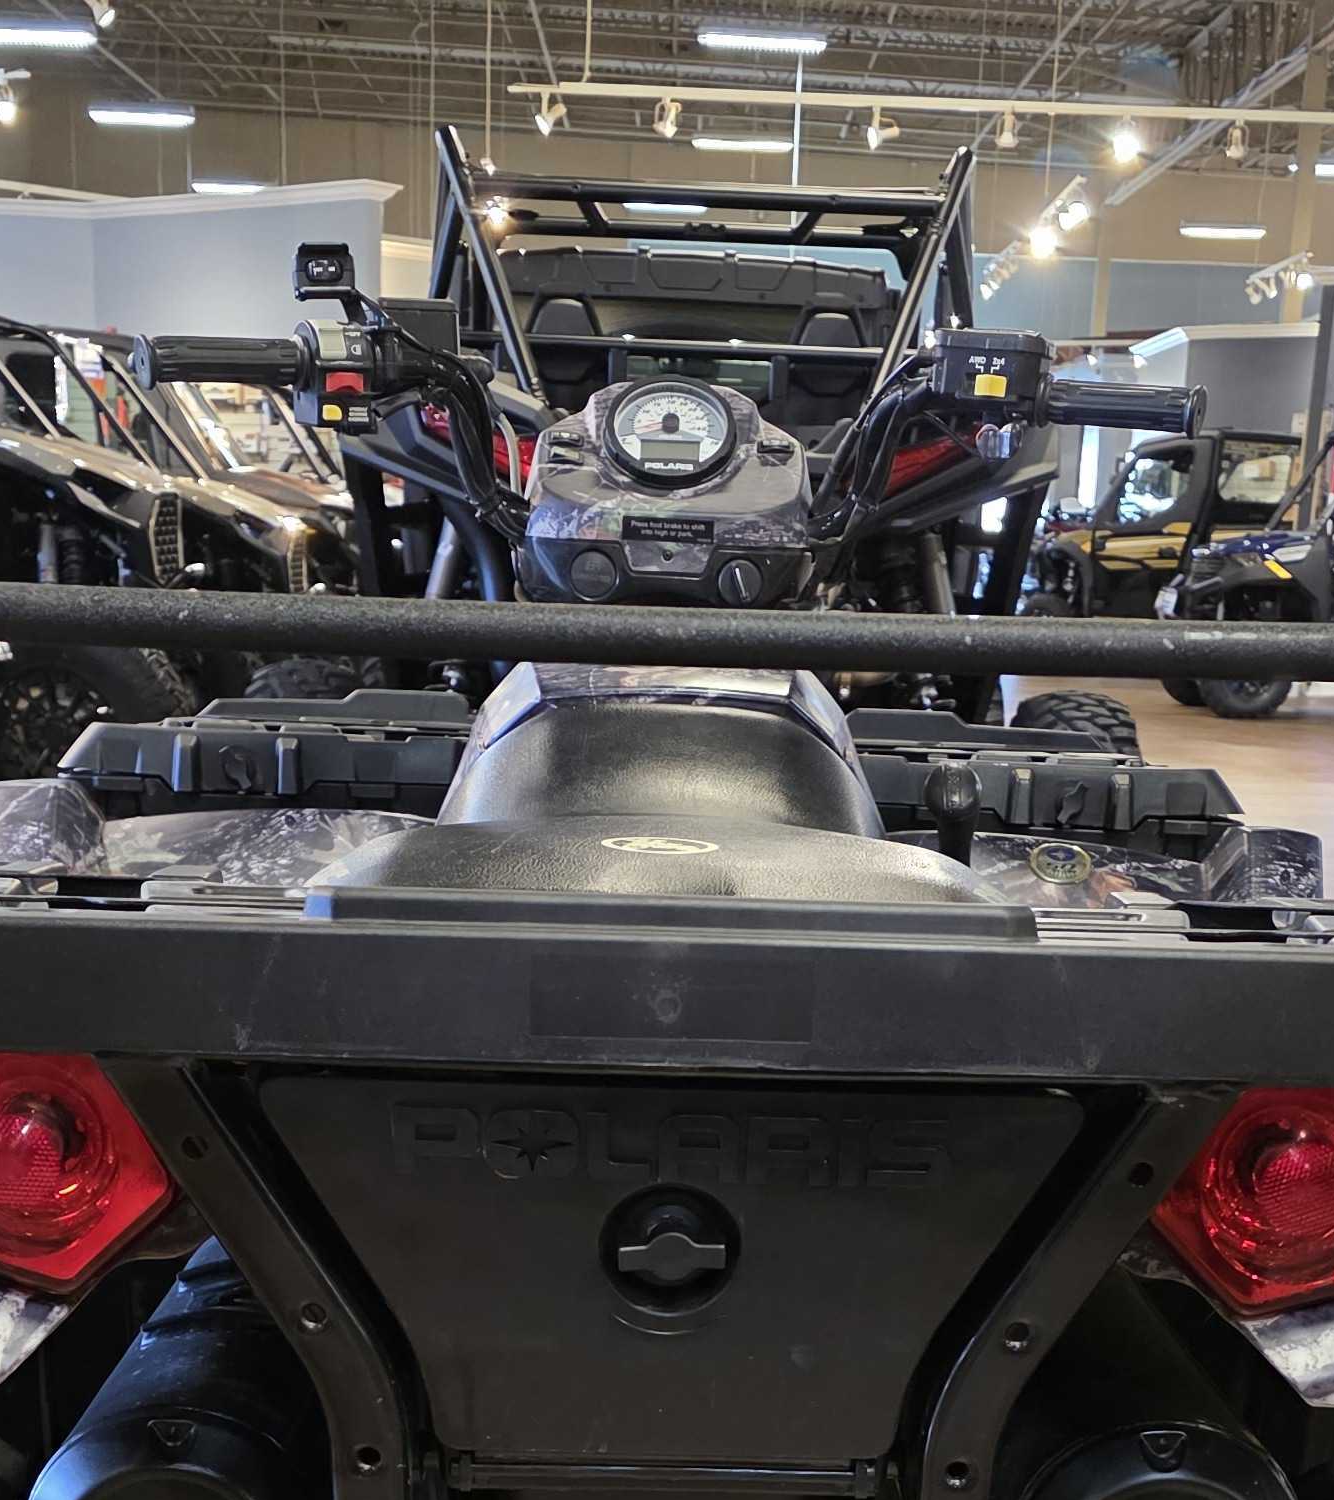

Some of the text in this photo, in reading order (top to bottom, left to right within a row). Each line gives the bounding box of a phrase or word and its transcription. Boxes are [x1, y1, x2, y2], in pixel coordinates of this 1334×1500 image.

[968, 355, 987, 364] AWD
[644, 462, 694, 470] POLARIS
[390, 1105, 951, 1189] POLARIS
